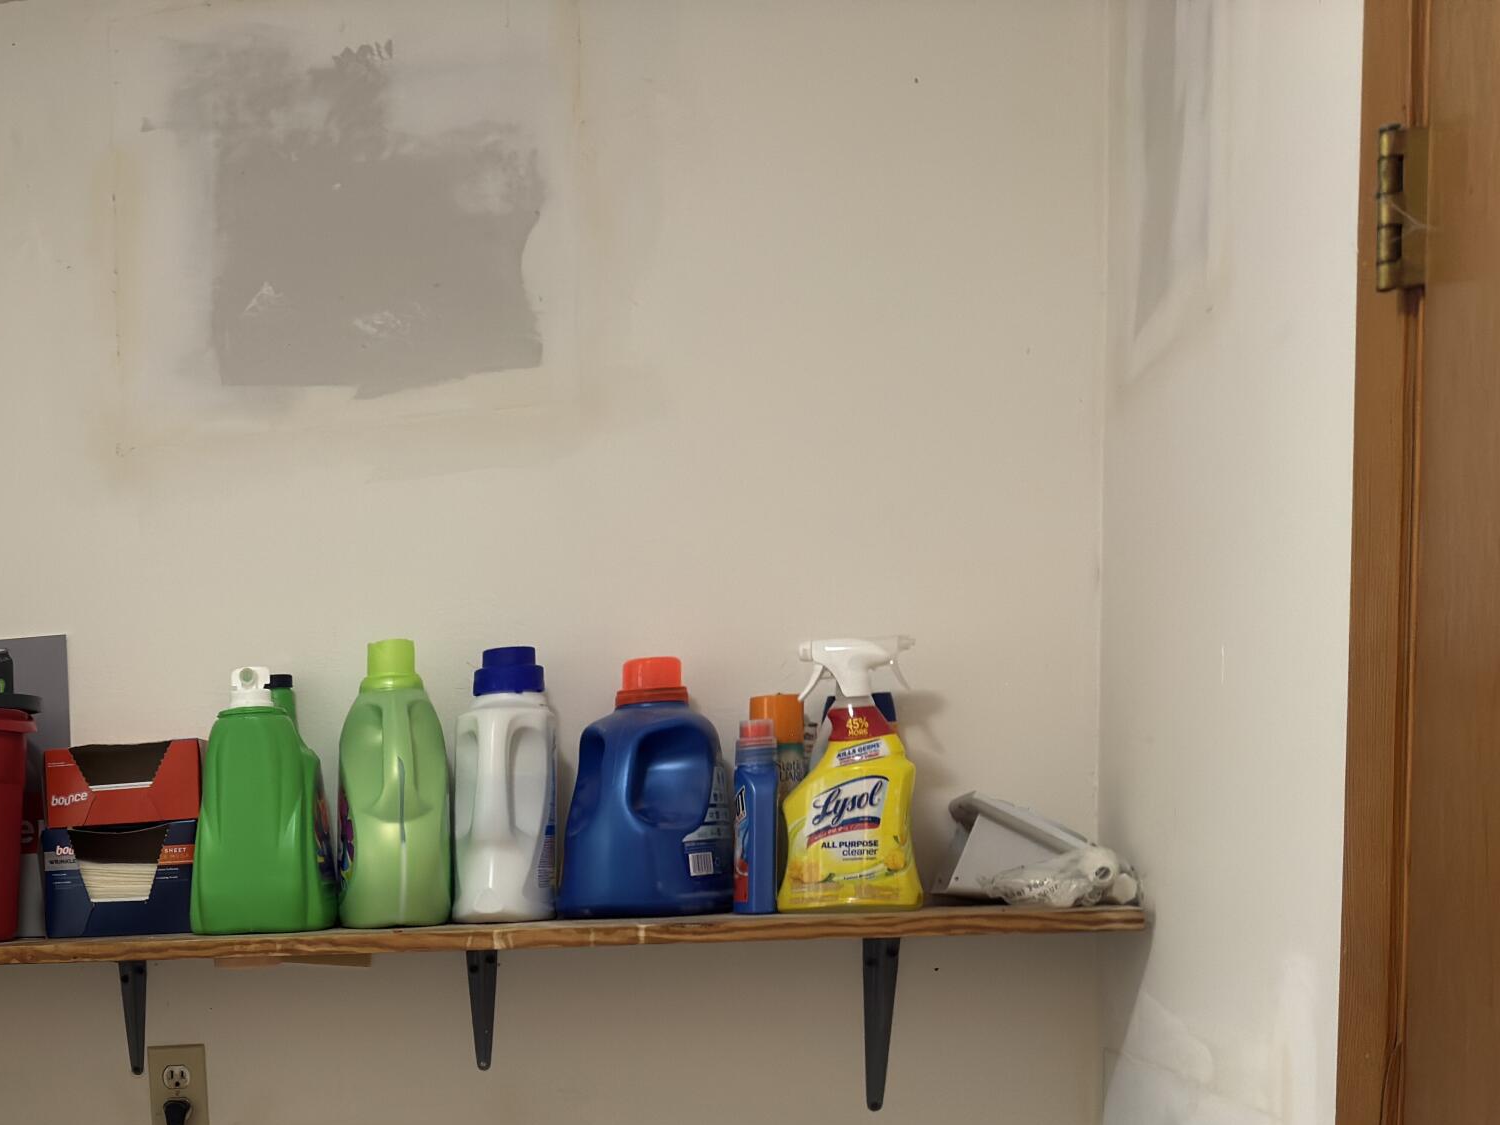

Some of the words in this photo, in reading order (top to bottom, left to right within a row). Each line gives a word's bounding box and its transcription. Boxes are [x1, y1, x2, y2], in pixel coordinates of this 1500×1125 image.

[846, 717, 869, 730] 45%
[51, 792, 88, 806] bounce
[812, 780, 883, 825] Lysol
[838, 840, 879, 848] PURPOSE
[842, 848, 879, 857] cleaner
